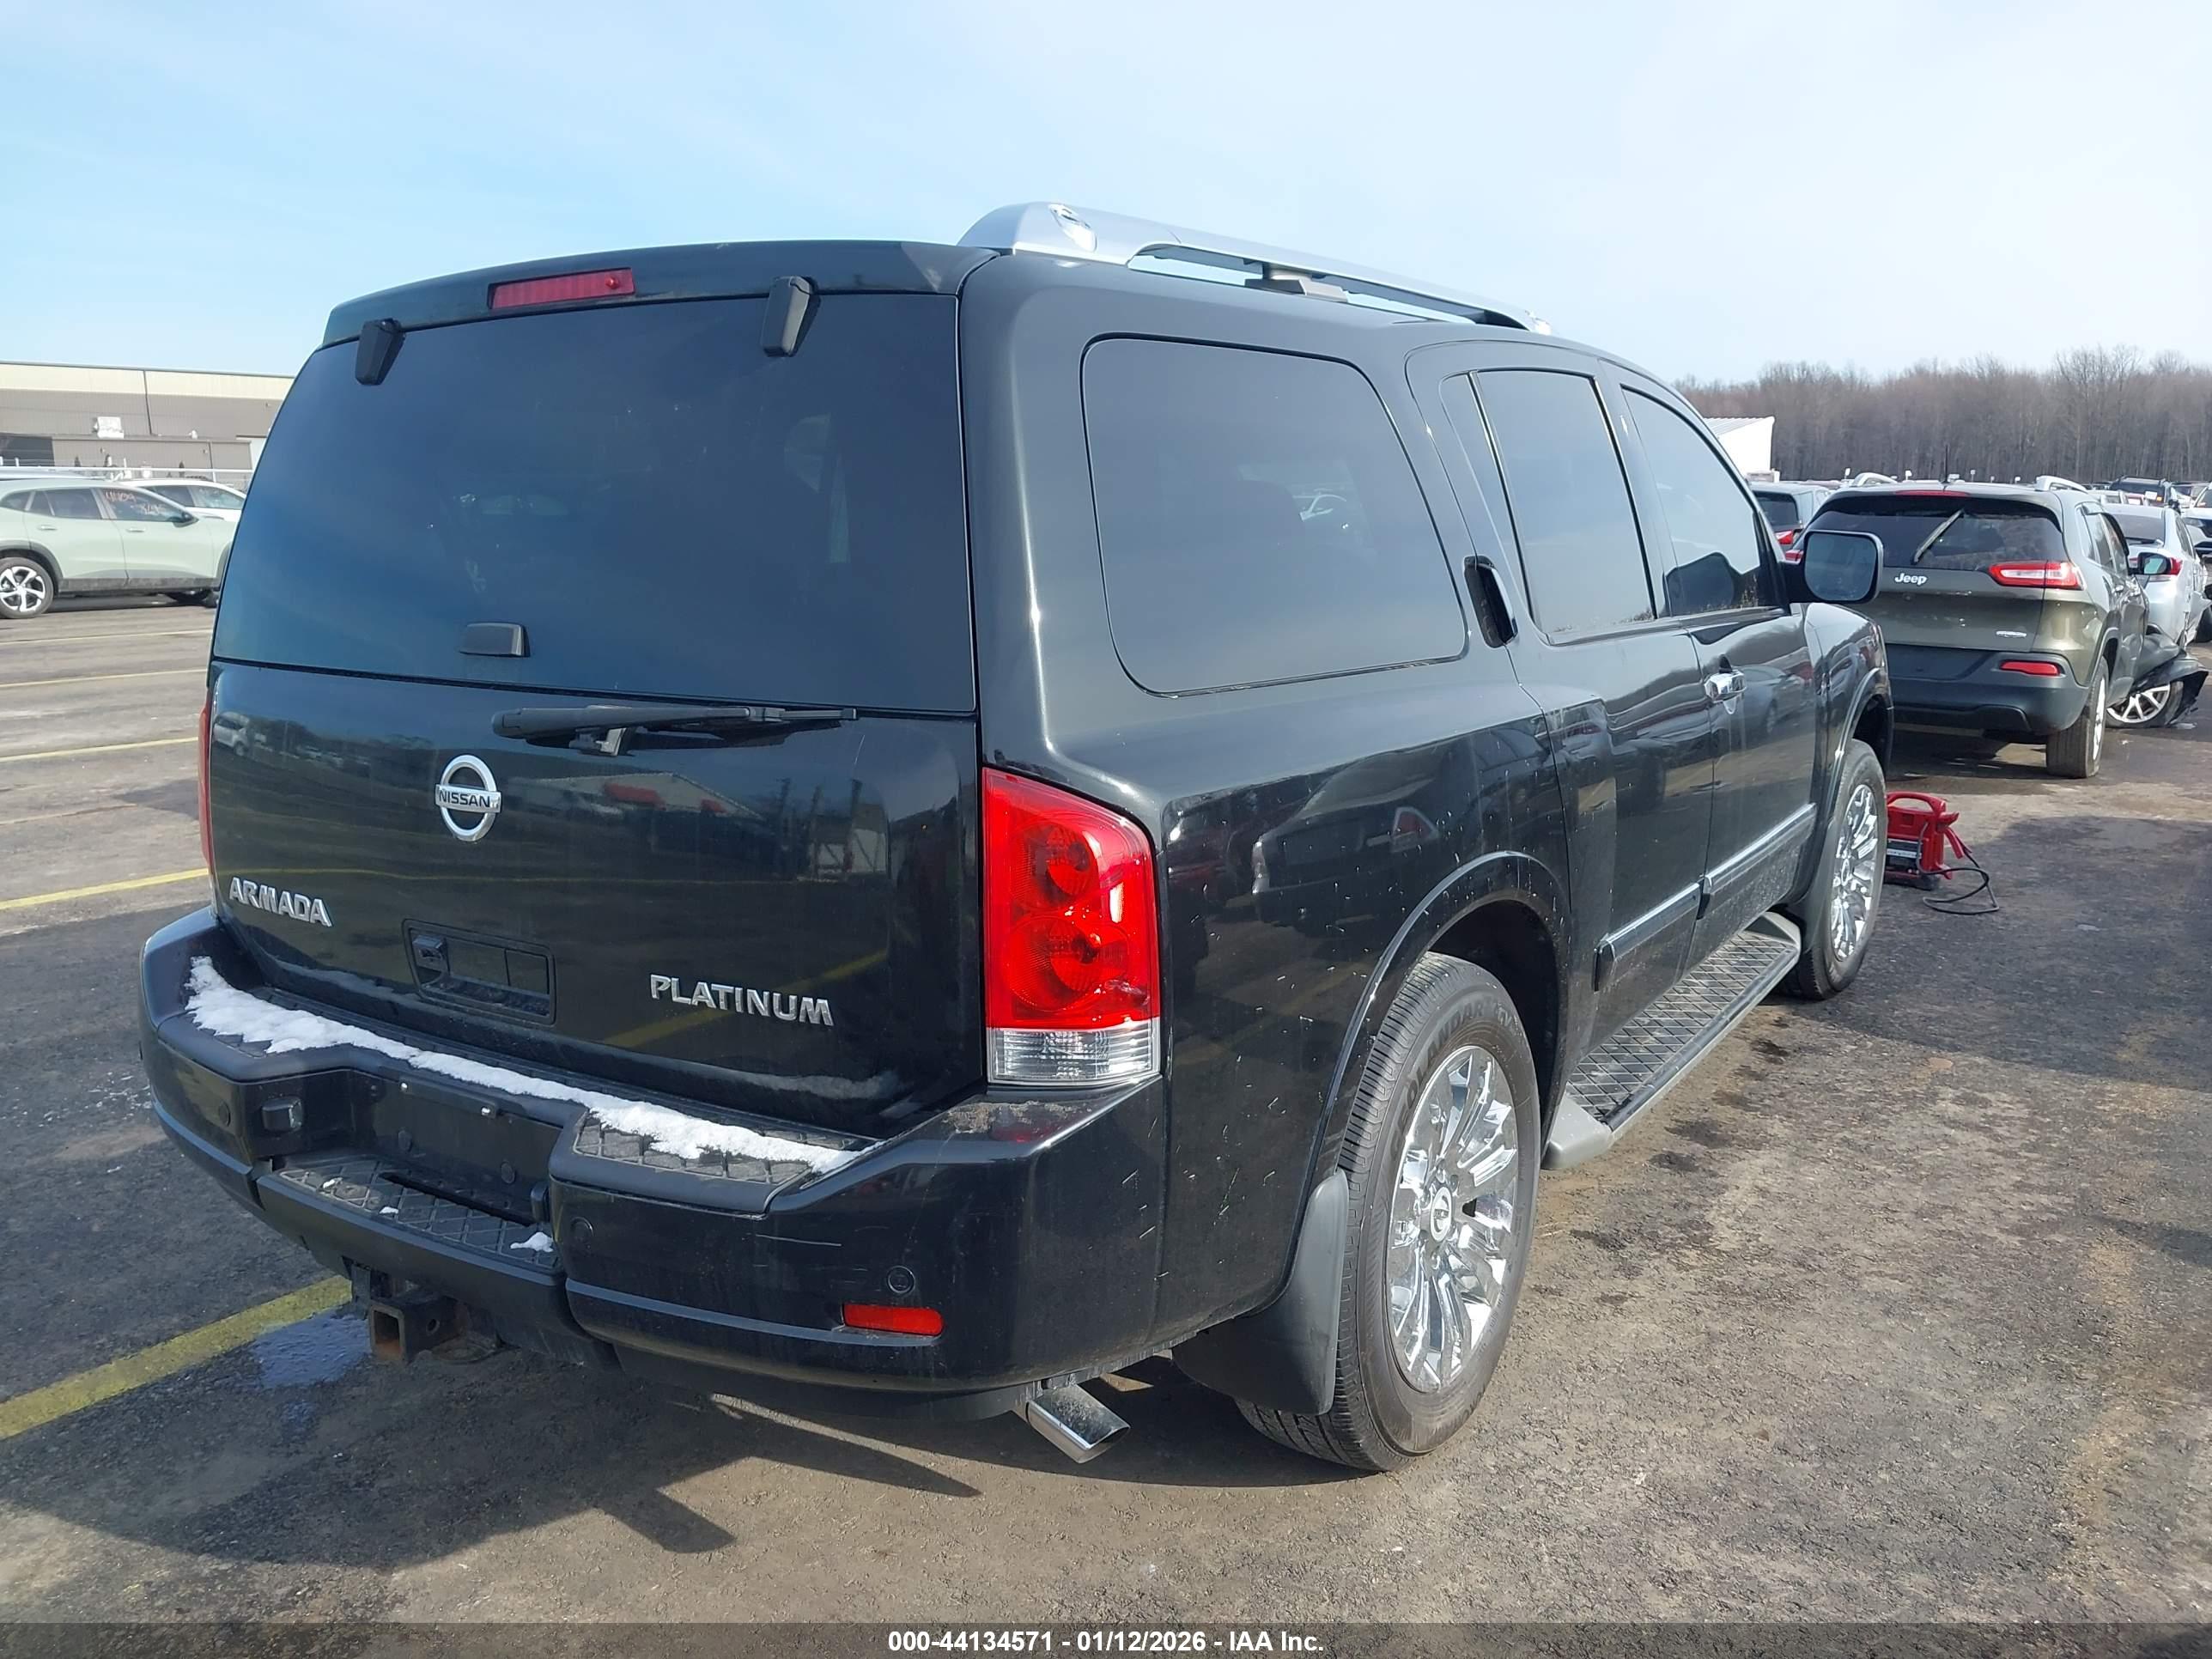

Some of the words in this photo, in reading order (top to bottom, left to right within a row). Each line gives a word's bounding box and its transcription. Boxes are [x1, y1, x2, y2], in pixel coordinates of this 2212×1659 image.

[1894, 572, 1928, 586] Jeep
[439, 789, 490, 808] NISSAN
[228, 876, 332, 927] ARMADA
[649, 973, 835, 1027] PLATINUM
